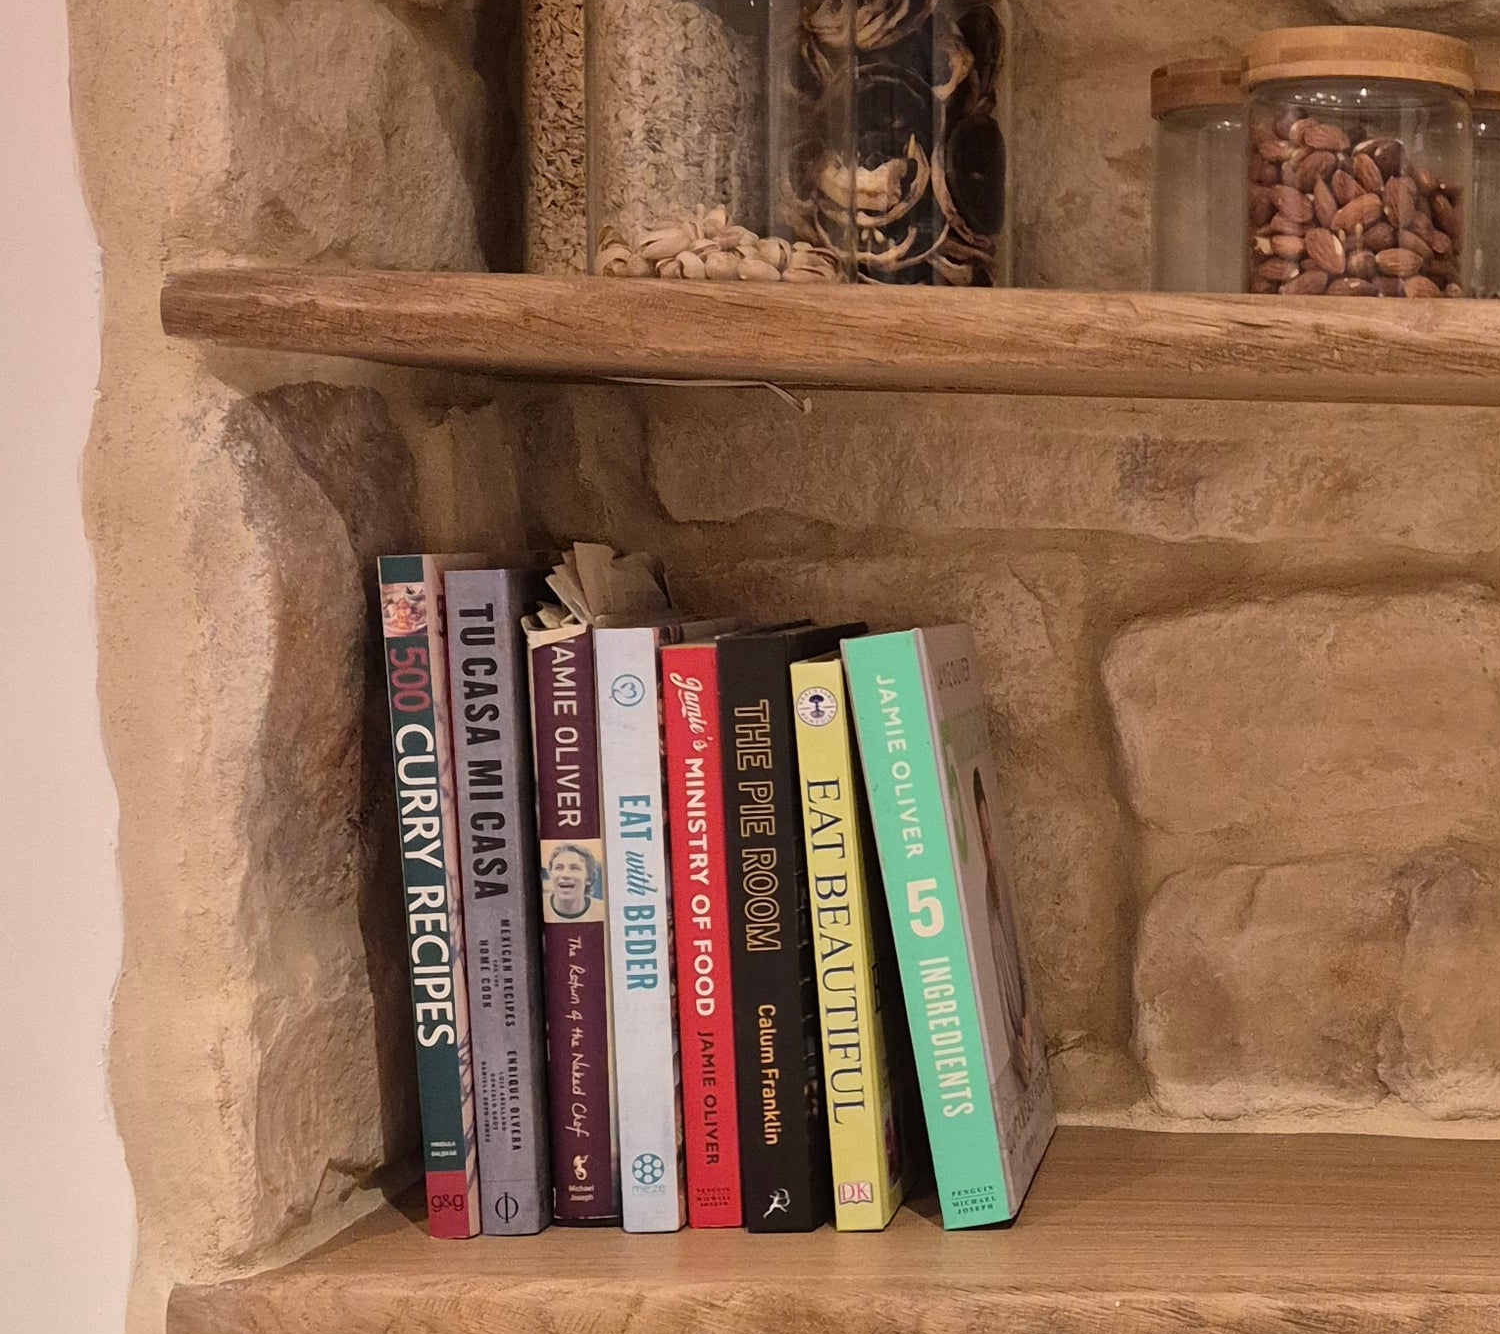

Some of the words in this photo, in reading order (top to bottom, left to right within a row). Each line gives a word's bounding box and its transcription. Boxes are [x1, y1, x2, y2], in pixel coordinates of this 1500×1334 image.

[459, 603, 496, 646] TU
[389, 646, 431, 713] 500
[461, 657, 501, 746] CASA
[552, 639, 577, 716] AMIE
[669, 672, 714, 752] Jamie's
[734, 699, 772, 771] THE
[876, 675, 907, 754] JAMIE
[395, 723, 443, 869] CURRY
[467, 760, 503, 800] MI
[554, 727, 581, 827] OLIVER
[618, 795, 652, 841] EAT
[684, 758, 710, 886] MINISTRY
[738, 780, 776, 838] PIE
[806, 776, 846, 859] EAT
[891, 761, 924, 859] OLIVER
[470, 811, 509, 900] CASA
[624, 850, 658, 897] with
[691, 893, 712, 930] OF
[742, 847, 781, 952] ROOM
[906, 878, 945, 938] 5
[407, 885, 455, 1048] RECIPES
[479, 940, 491, 971] HOME
[500, 919, 513, 972] MEXICAN
[568, 936, 582, 957] The
[623, 905, 658, 990] BEDER
[481, 977, 492, 1008] COOK
[503, 978, 516, 1027] RECIPES
[569, 964, 585, 1005] Return
[693, 939, 715, 1017] FOOD
[815, 870, 866, 1125] BEAUTIFUL
[571, 1027, 584, 1048] the
[697, 1032, 717, 1087] JAMIE
[758, 1004, 777, 1064] Calum
[918, 956, 975, 1118] INGREDIENTS
[507, 1050, 520, 1101] ENRIQUE
[572, 1053, 590, 1096] Naked
[509, 1107, 522, 1151] OLVERA
[566, 1103, 590, 1137] Chef
[704, 1095, 719, 1165] OLIVER
[761, 1069, 782, 1145] Franklin
[431, 1193, 464, 1212] g&g
[841, 1183, 869, 1201] DK
[951, 1185, 993, 1197] PENGUIN
[951, 1196, 997, 1207] MICHAEL
[957, 1203, 994, 1214] JOSEPH
